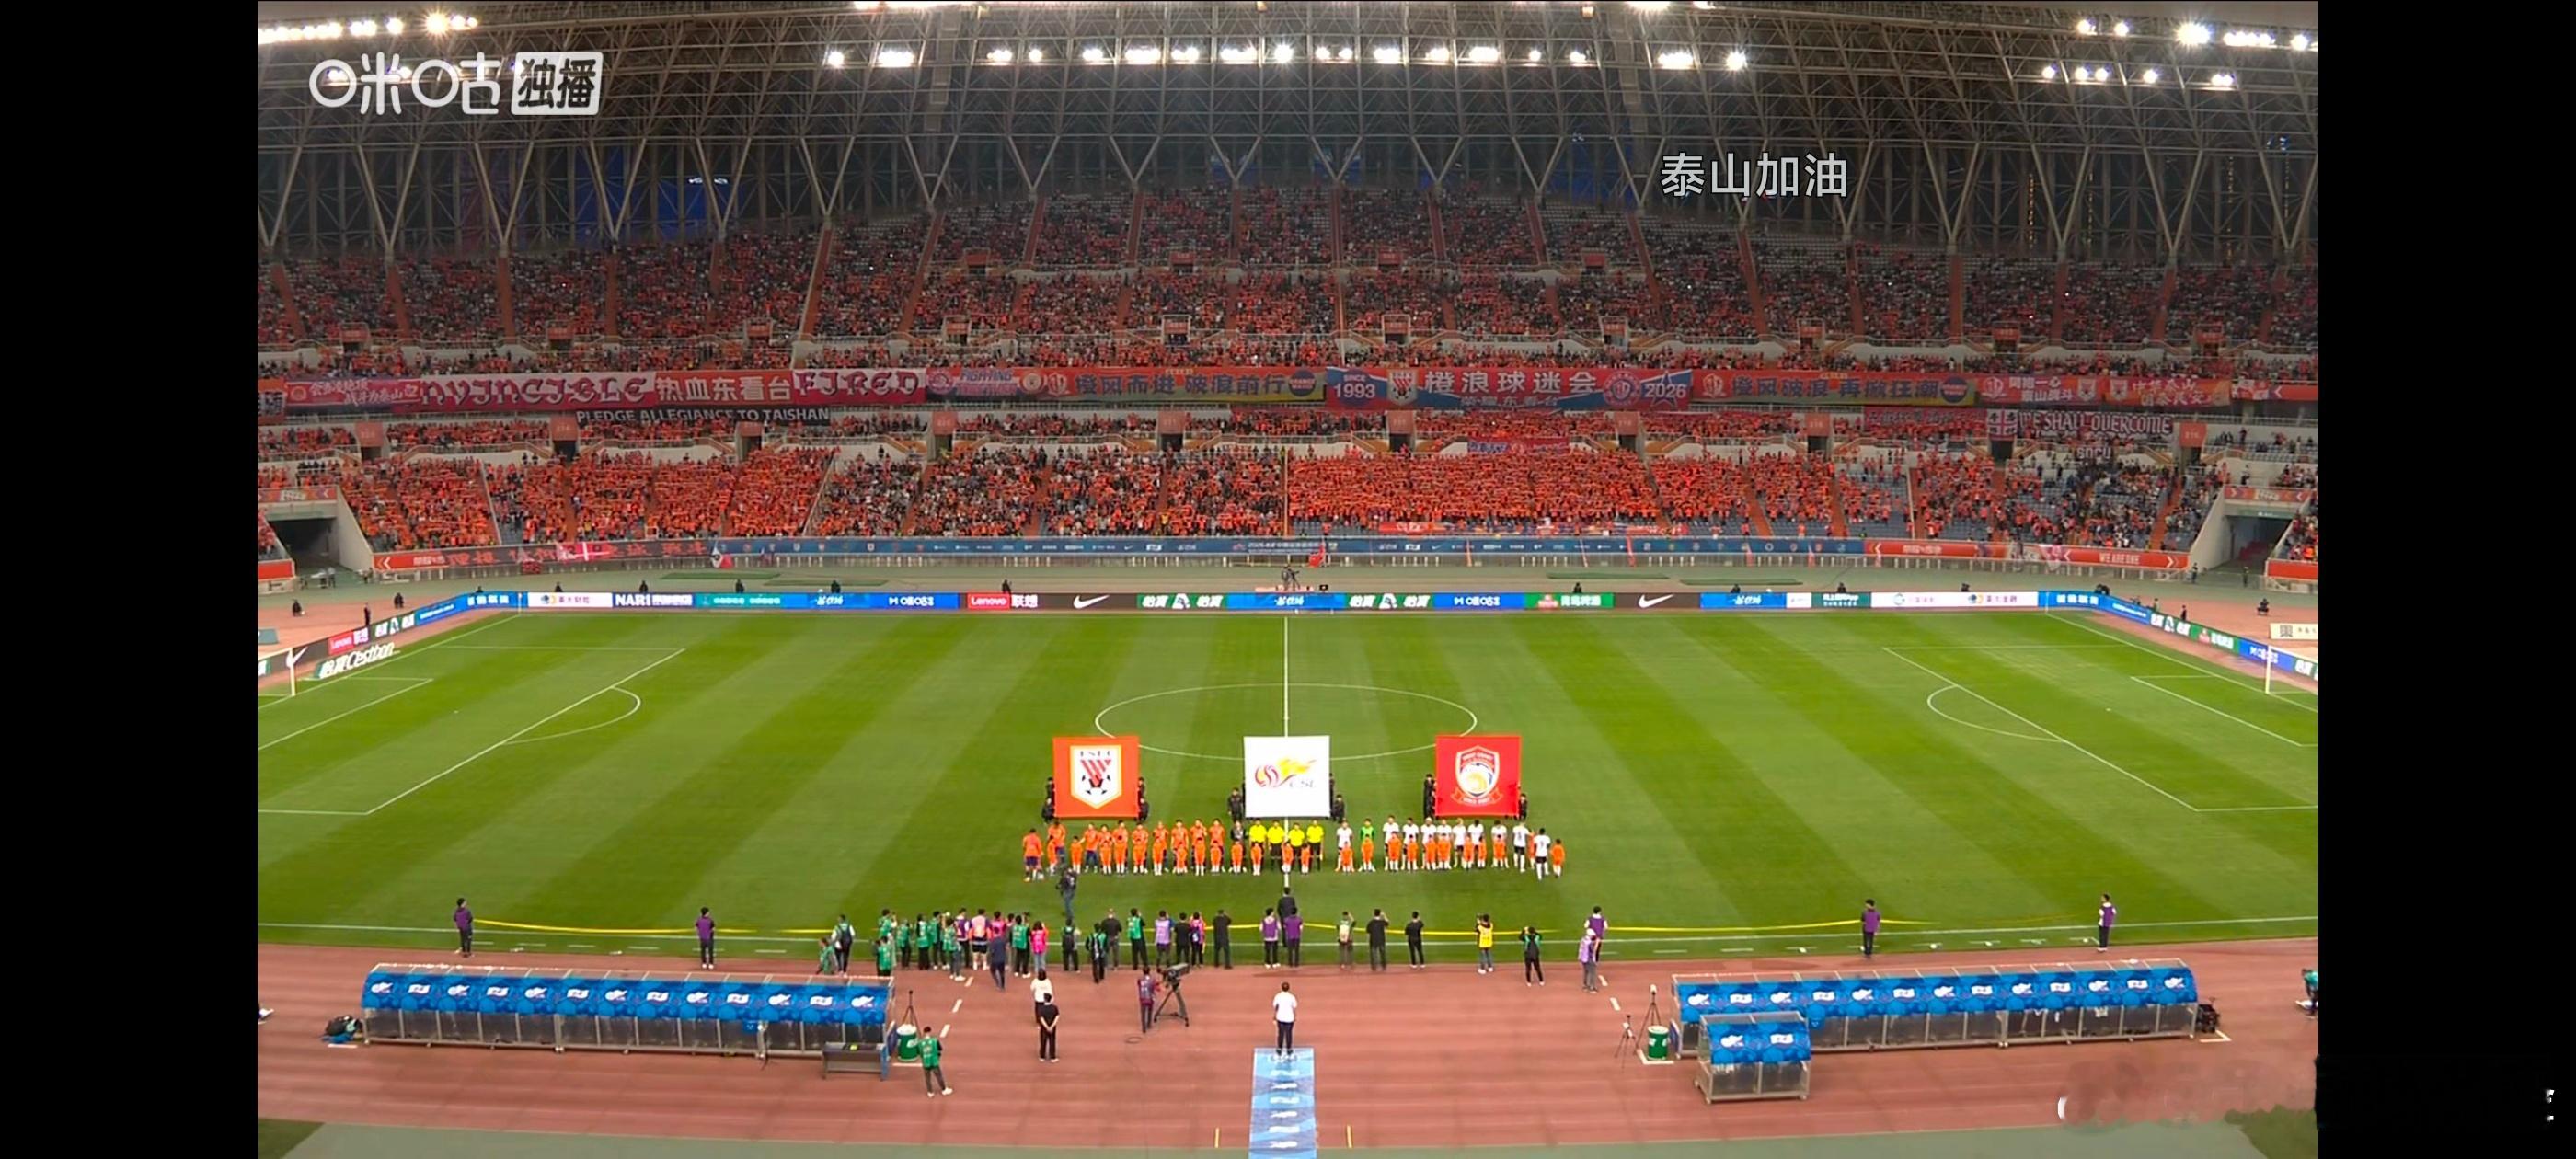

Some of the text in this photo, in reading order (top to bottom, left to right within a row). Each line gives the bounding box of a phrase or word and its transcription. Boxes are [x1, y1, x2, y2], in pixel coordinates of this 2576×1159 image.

[655, 375, 792, 402] 热血东看台
[1424, 371, 1597, 394] 橙浪球迷会
[1645, 383, 1687, 398] 2026
[421, 377, 647, 405] NVINCIBLE
[1334, 383, 1376, 399] 1993
[576, 408, 829, 424] PLEDGE ALLEGIANCE TO TAISHAN
[2043, 411, 2090, 430] SHALL
[2091, 413, 2171, 434] OVERCOME
[615, 594, 651, 607] NARI
[971, 597, 1007, 607] Lenovo
